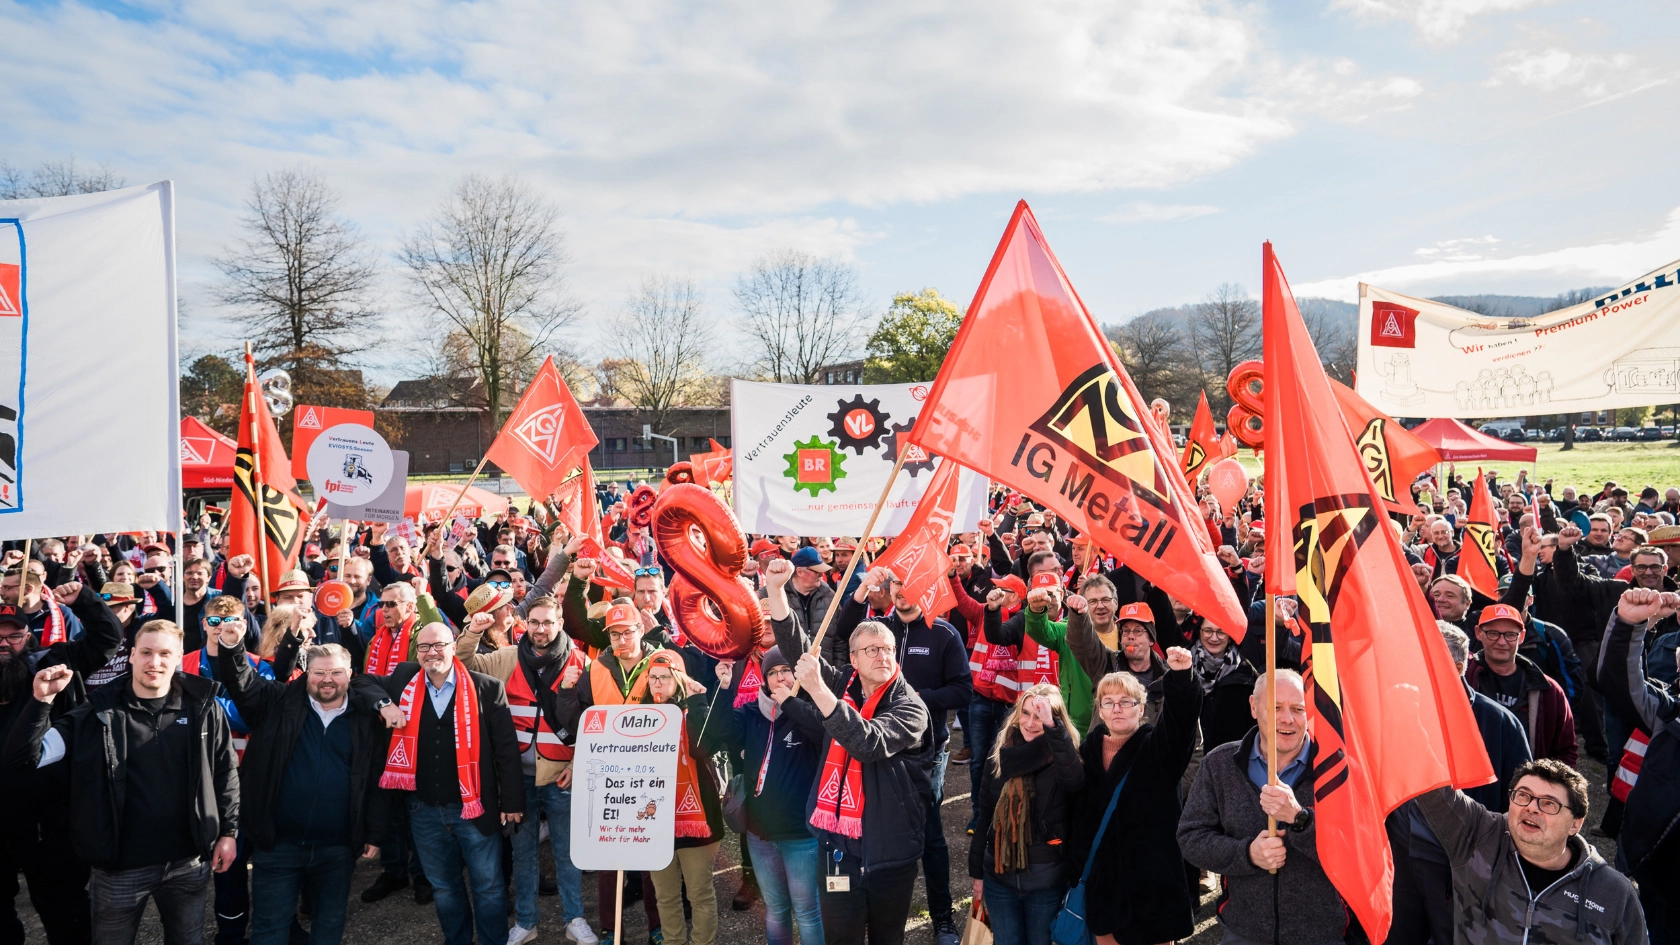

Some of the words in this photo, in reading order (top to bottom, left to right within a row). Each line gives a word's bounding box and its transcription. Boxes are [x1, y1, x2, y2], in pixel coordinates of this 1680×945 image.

[1535, 312, 1598, 338] Premium
[1601, 294, 1650, 317] Power
[1461, 343, 1485, 354] Wir
[1492, 349, 1531, 362] verdienen
[744, 394, 813, 462] Vertrauensleute
[845, 414, 874, 436] VL
[803, 458, 826, 472] BR
[324, 478, 341, 493] fpi
[1011, 433, 1056, 483] IG
[1059, 461, 1178, 560] Metall
[886, 499, 909, 508] läuft
[365, 507, 400, 515] MITEINANDER
[621, 714, 659, 729] Mahr
[589, 742, 677, 753] Vertrauensleute
[605, 777, 625, 789] Das
[630, 778, 644, 788] ist
[649, 778, 665, 789] ein
[603, 793, 637, 805] faules
[603, 808, 619, 820] EI!
[599, 825, 613, 833] Wir
[615, 825, 626, 833] für
[628, 825, 646, 833] mehr
[599, 835, 616, 843] Mehr
[619, 835, 631, 843] für
[633, 835, 651, 843] Mahr
[1585, 898, 1605, 913] MORE
